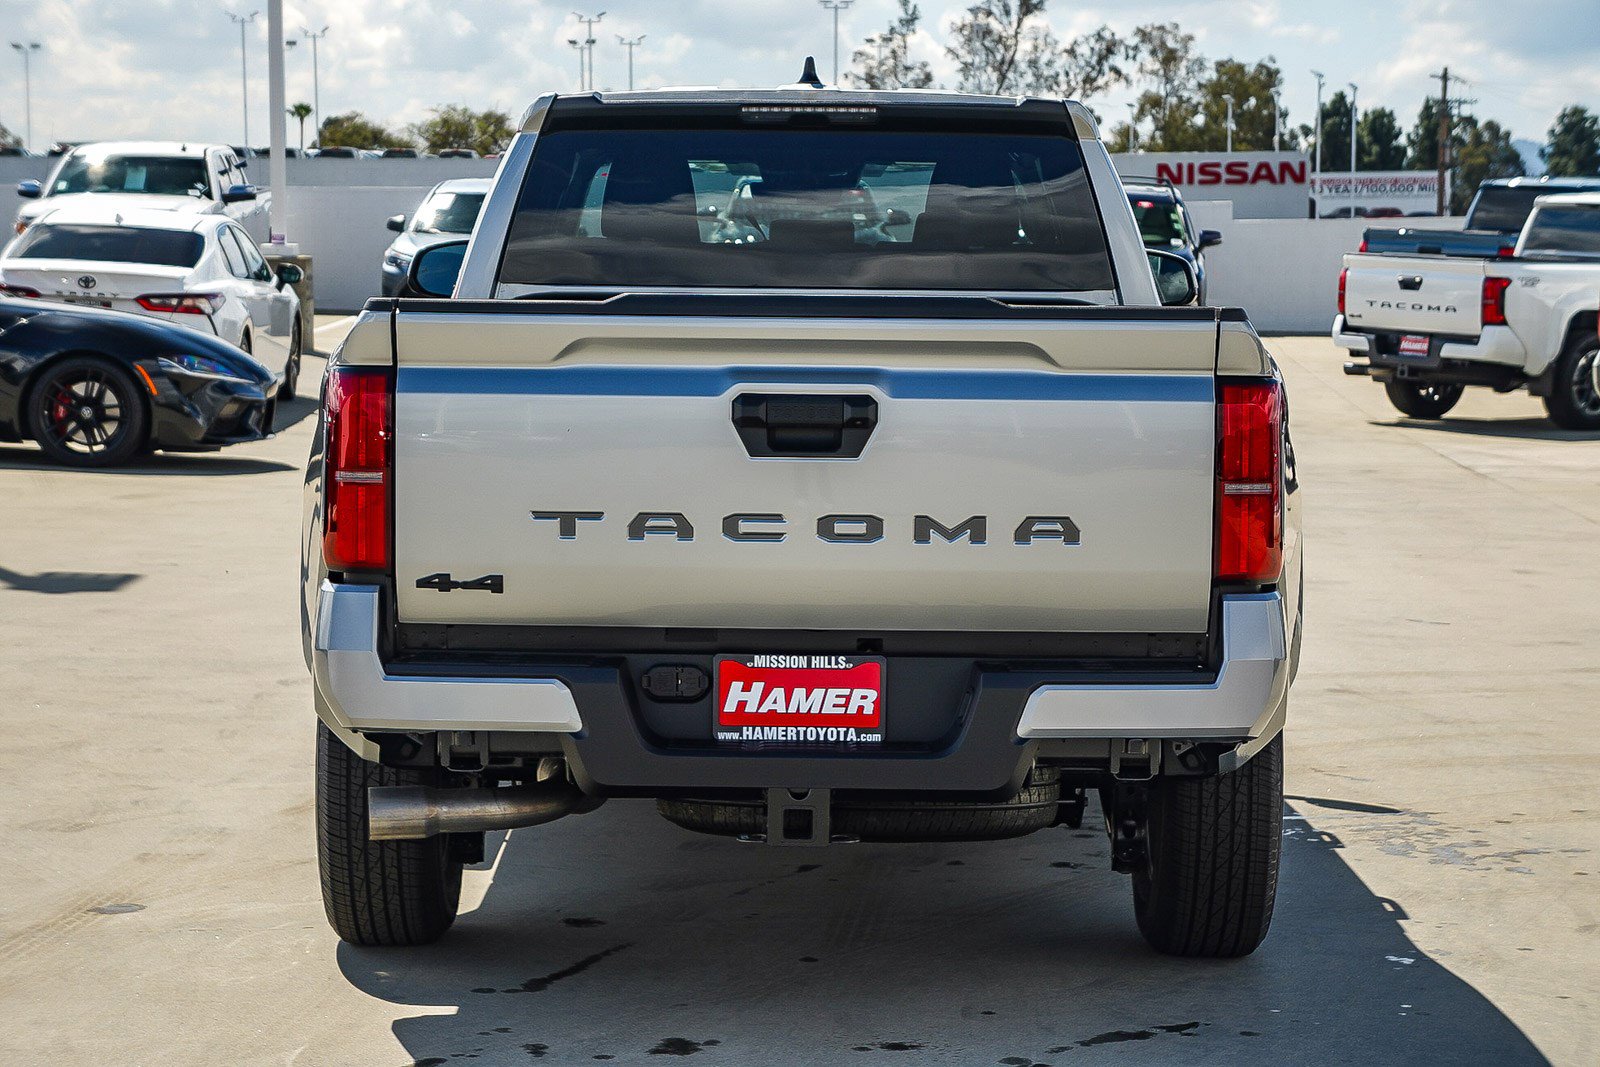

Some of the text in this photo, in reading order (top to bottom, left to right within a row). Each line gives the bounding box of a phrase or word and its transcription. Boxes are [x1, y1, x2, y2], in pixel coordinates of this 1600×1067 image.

[1156, 161, 1306, 185] NISSAN
[1365, 299, 1458, 313] TACOMA
[530, 510, 1082, 546] TACOMA
[753, 655, 847, 669] MISSION HILLS
[723, 680, 878, 715] HAMER
[717, 726, 882, 742] www.HAMERTOYOTA.com
